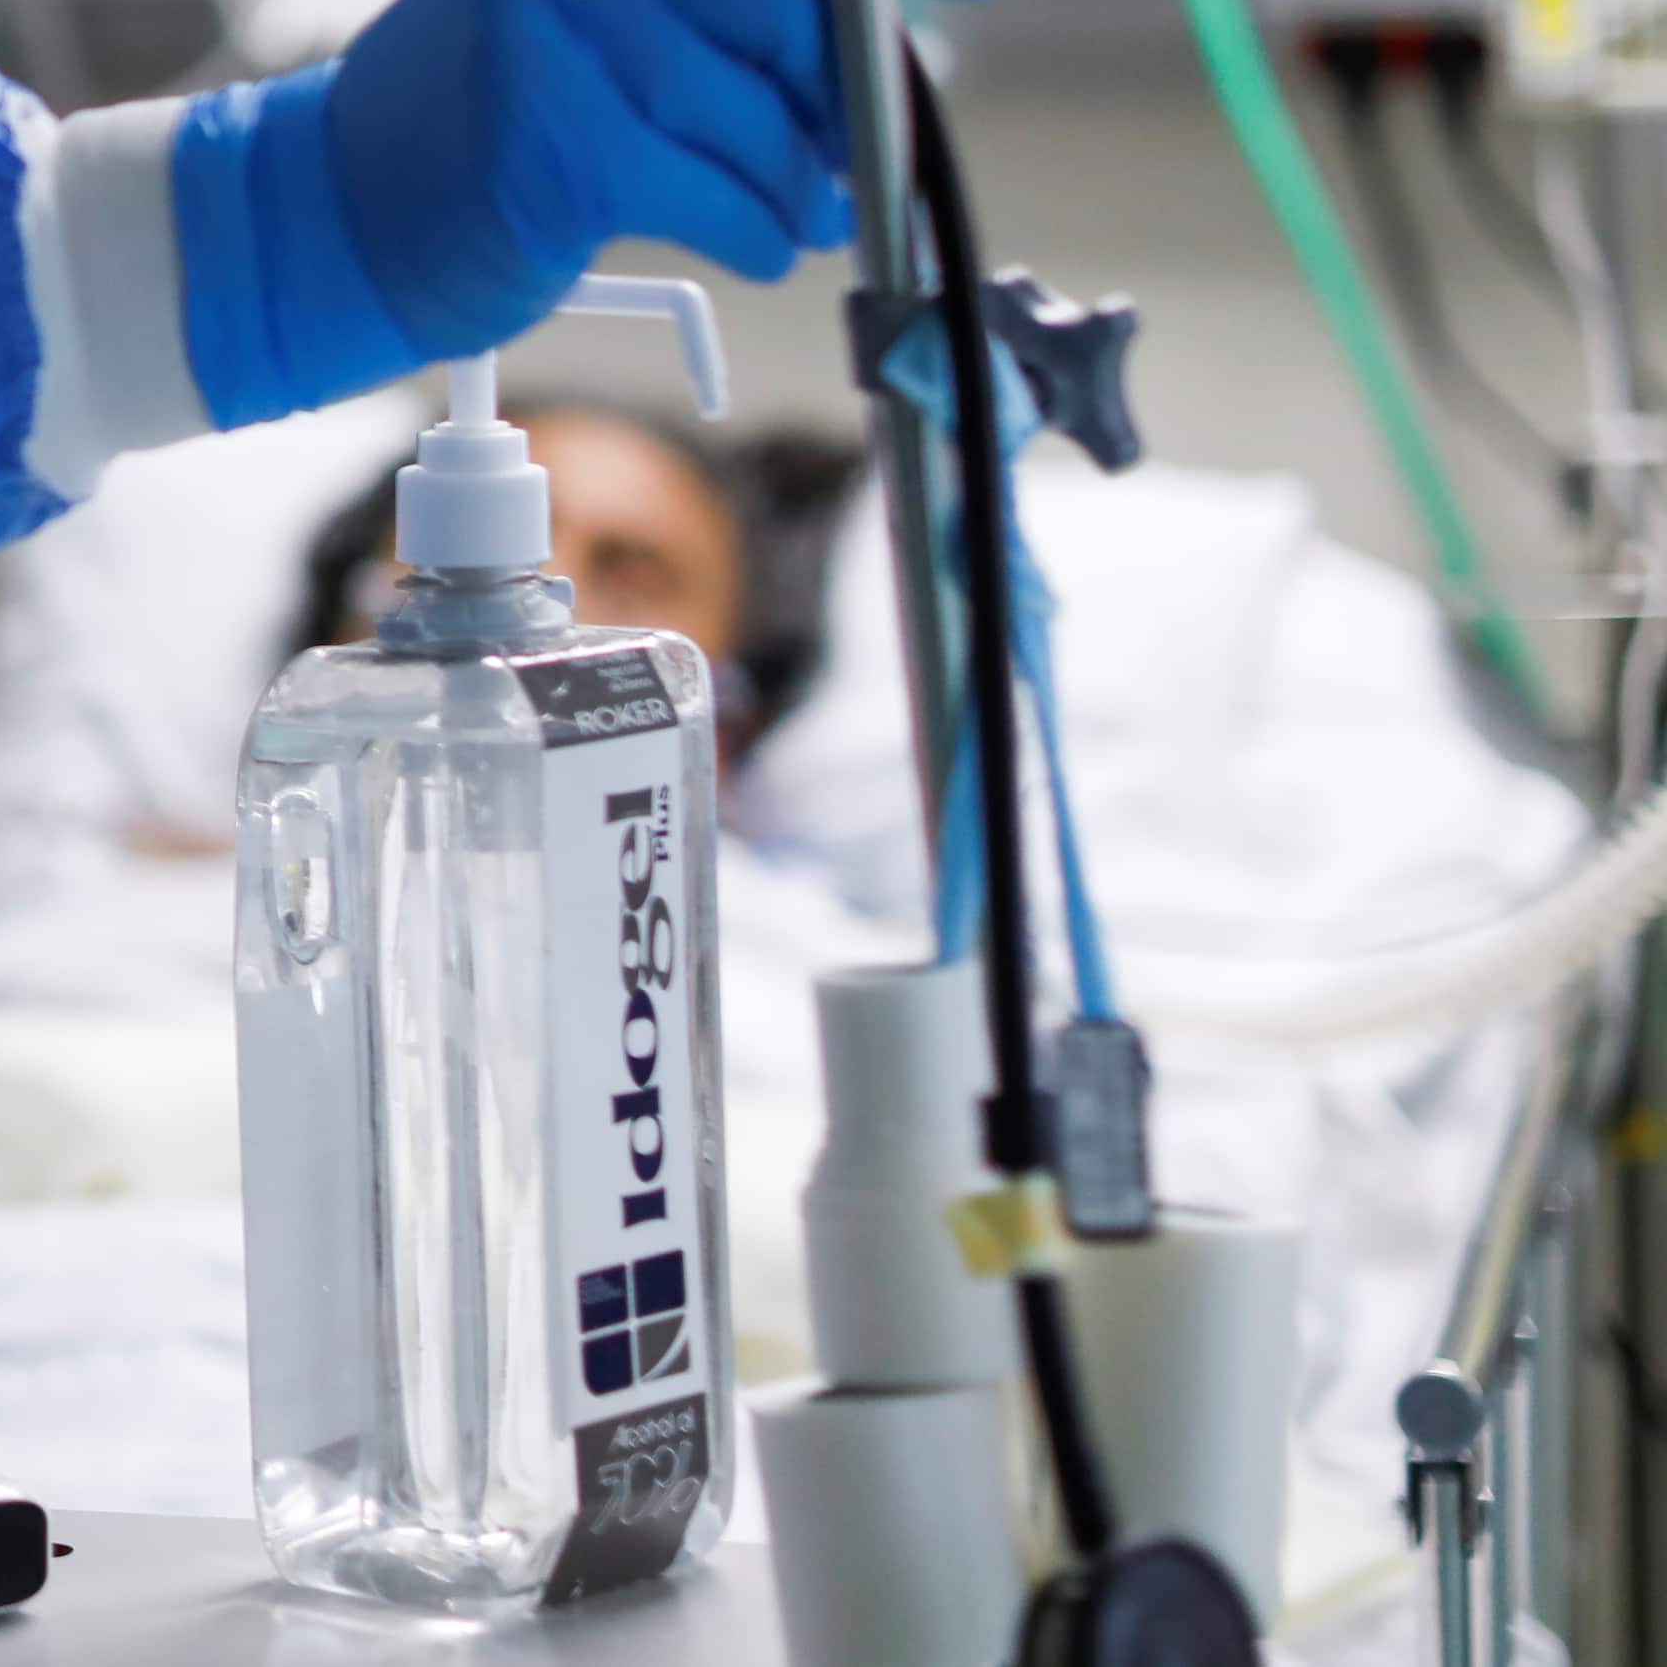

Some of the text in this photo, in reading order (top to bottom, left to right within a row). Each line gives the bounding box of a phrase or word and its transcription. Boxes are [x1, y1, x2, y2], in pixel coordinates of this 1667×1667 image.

[573, 697, 670, 736] ROKER
[652, 785, 670, 862] Plus
[604, 786, 676, 1229] Idogel
